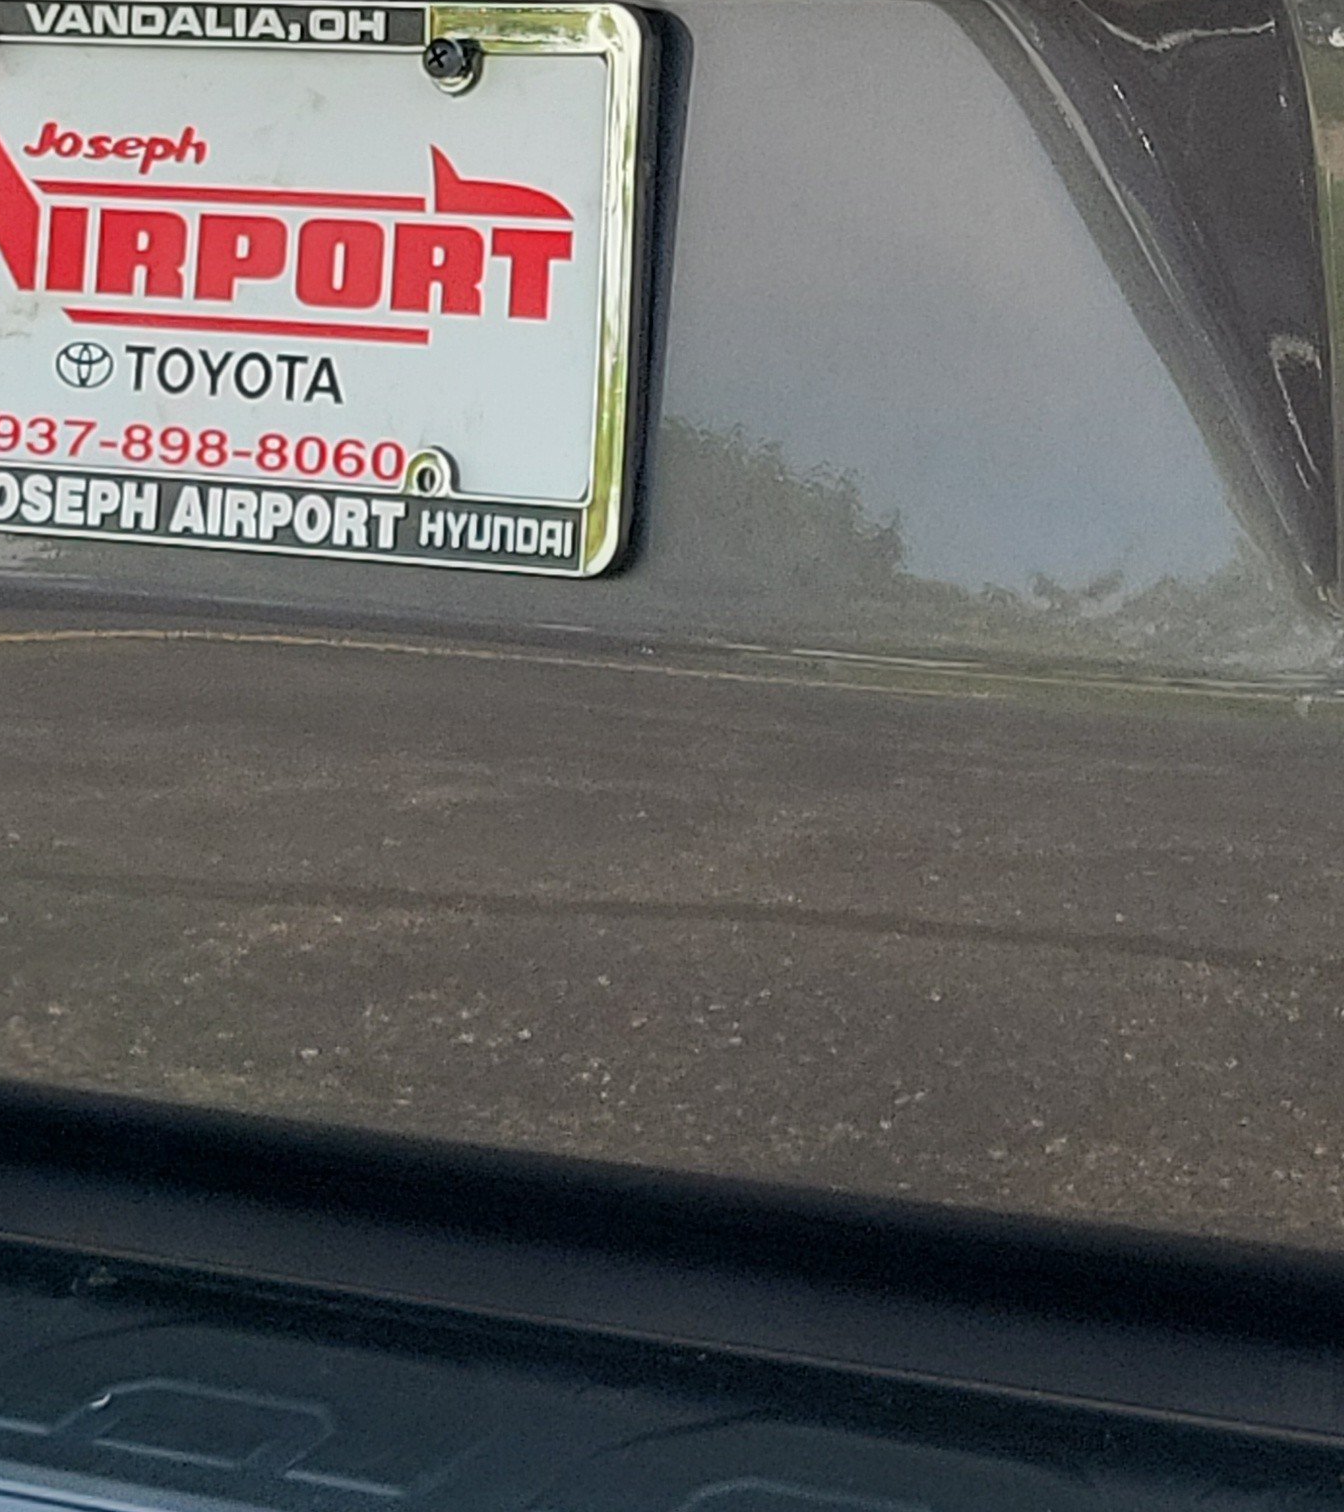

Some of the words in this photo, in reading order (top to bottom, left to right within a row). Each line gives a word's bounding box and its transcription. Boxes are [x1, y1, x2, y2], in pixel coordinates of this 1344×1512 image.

[23, 122, 208, 175] Joseph
[124, 345, 344, 406] TOYOTA
[168, 487, 407, 552] AIRPORT
[418, 510, 576, 559] HYUNDAI
